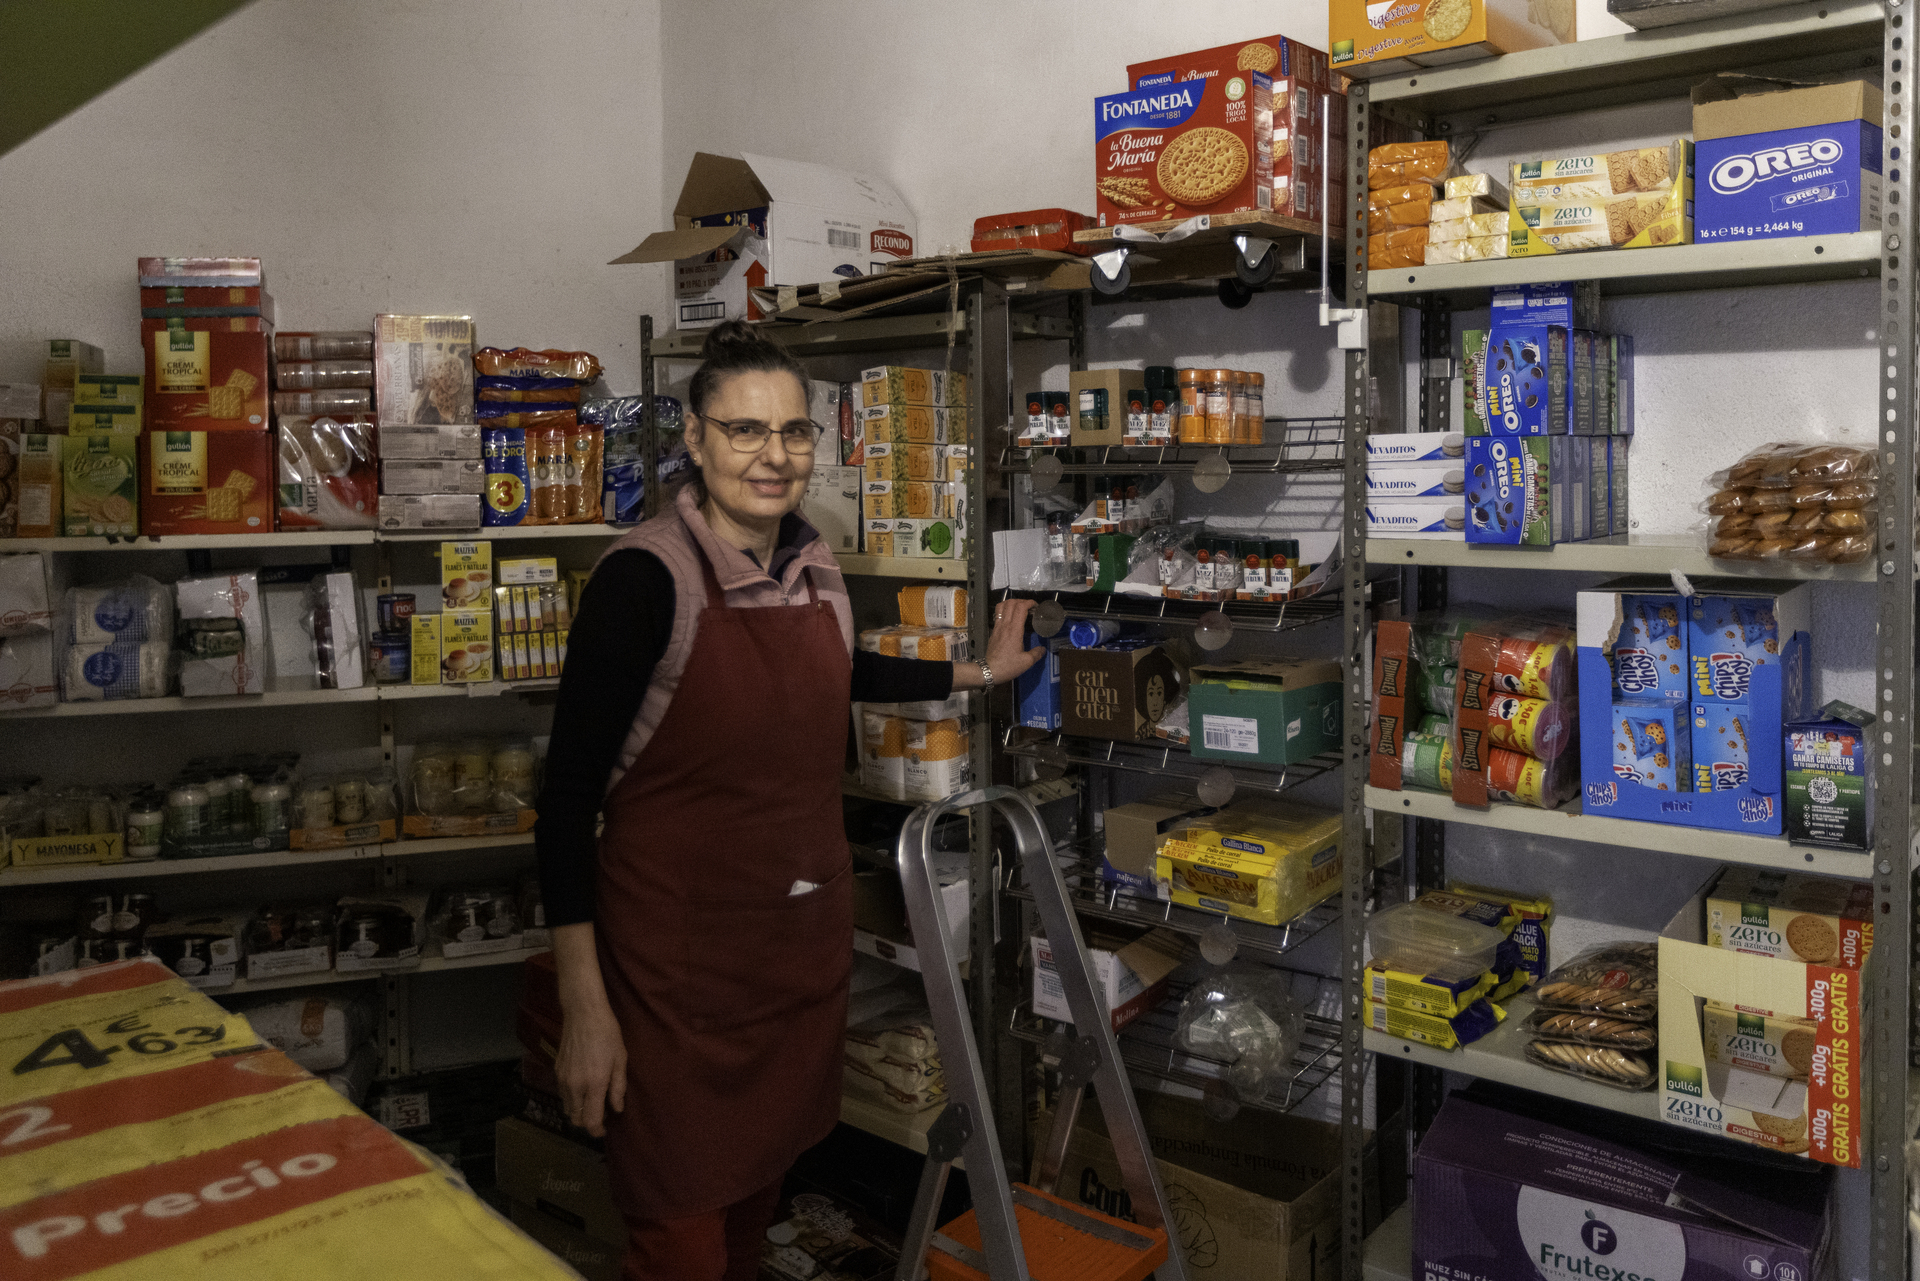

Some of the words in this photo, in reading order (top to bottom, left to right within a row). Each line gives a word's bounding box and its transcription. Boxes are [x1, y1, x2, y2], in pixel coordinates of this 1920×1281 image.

[1357, 37, 1404, 60] Digestive
[1404, 34, 1424, 46] Avena
[1332, 52, 1354, 63] gullón
[1139, 75, 1172, 88] FONTANEDA
[1187, 69, 1219, 81] Buena
[1102, 89, 1193, 122] FONTANEDA
[1166, 110, 1181, 120] 1881
[1225, 109, 1246, 118] TRIGO
[1226, 100, 1246, 111] 100%
[1226, 115, 1248, 124] LOCAL
[1111, 141, 1119, 151] la
[1119, 133, 1164, 152] Buena
[1107, 149, 1156, 171] María
[1556, 156, 1594, 170] zero
[1715, 141, 1840, 189] OREO
[1521, 170, 1541, 179] gullón
[1566, 167, 1594, 176] azúcares
[1791, 166, 1834, 184] ORIGINAL
[1785, 186, 1821, 205] OREO
[1136, 209, 1157, 218] CEREALES
[1555, 206, 1592, 220] zero
[1565, 217, 1592, 226] azúcares
[1660, 211, 1680, 220] Fibra
[1700, 228, 1710, 238] 16
[1711, 230, 1717, 238] x
[1730, 225, 1745, 236] 154
[1747, 226, 1754, 237] g
[1764, 221, 1790, 234] 2,464
[1792, 220, 1804, 232] kg
[874, 234, 910, 250] RECONDO
[1511, 238, 1528, 246] gullón
[171, 342, 194, 351] gullón
[162, 368, 202, 376] TROPICAL
[509, 368, 540, 377] MARÍA
[1476, 362, 1484, 399] CAMISETAS
[1477, 398, 1486, 420] GANAR
[1500, 373, 1519, 430] OREO
[166, 442, 192, 452] gullón
[485, 447, 498, 458] DE
[501, 446, 524, 457] ORO
[537, 454, 573, 464] MARÍA
[1524, 453, 1534, 475] GANAR
[536, 464, 576, 480] ORO
[1491, 442, 1510, 498] OREO
[306, 476, 318, 515] María
[1526, 474, 1534, 511] CAMISETAS
[454, 546, 478, 555] MAIZENA
[467, 563, 488, 571] NATILLAS
[454, 617, 478, 626] MAIZENA
[1075, 670, 1109, 687] car
[1380, 657, 1400, 696] PRINGLES
[1618, 652, 1642, 694] Chips
[1714, 658, 1741, 700] Chips
[1075, 685, 1119, 704] men
[1075, 700, 1114, 720] cita
[1518, 702, 1538, 726] 1,40€
[1026, 720, 1048, 729] PESCADO
[1378, 716, 1398, 756] PRINGLES
[1460, 729, 1482, 771] PRINGLES
[1792, 753, 1815, 763] GANAR
[1816, 754, 1854, 766] CAMISETAS
[1525, 766, 1533, 786] 1,40€
[1586, 781, 1612, 798] Chips
[1738, 797, 1766, 813] Chips
[36, 843, 97, 858] MAYONESA
[1172, 840, 1198, 850] AVECREM
[1227, 850, 1242, 858] corral
[1223, 838, 1242, 850] Gallina
[1243, 842, 1264, 854] Blanca
[1164, 849, 1189, 860] AVECREM
[1197, 856, 1210, 864] Pollo
[1218, 860, 1233, 868] corral
[1187, 868, 1256, 894] AVECREM
[1742, 914, 1769, 926] gullón
[1729, 925, 1782, 946] zero
[1729, 939, 1748, 948] sin
[1749, 941, 1782, 953] azúcares
[1842, 929, 1860, 967] +100g
[1738, 1004, 1770, 1016] DIGESTIVE
[1810, 979, 1830, 1022] +100g
[1830, 972, 1849, 1034] GRATIS
[104, 1015, 152, 1034] €
[1115, 1006, 1139, 1026] Molina
[127, 1023, 226, 1055] 63
[1738, 1025, 1764, 1037] gullón
[13, 1028, 124, 1076] 4
[1725, 1034, 1777, 1057] zero
[1726, 1048, 1744, 1056] sin
[1745, 1050, 1777, 1064] azúcares
[1736, 1057, 1766, 1070] DIGESTIVE
[1812, 1044, 1831, 1087] +100g
[1668, 1078, 1701, 1096] gullón
[1666, 1096, 1722, 1122] zero
[1666, 1111, 1686, 1122] sin
[1687, 1115, 1722, 1132] azúcares
[1812, 1108, 1832, 1150] +100g
[1506, 1132, 1540, 1144] PRODUCTO
[1732, 1125, 1778, 1144] DIGESTIVE
[1832, 1102, 1850, 1162] GRATIS
[1504, 1136, 1528, 1146] LIMPIAS
[1574, 1153, 1593, 1164] PARA
[1594, 1159, 1616, 1170] EVITAR
[1538, 1133, 1598, 1152] CONDICIONES
[1600, 1149, 1612, 1157] DE
[1246, 1150, 1306, 1182] Fórmula
[1544, 1169, 1578, 1182] HUMEDAD
[1578, 1178, 1608, 1189] RELATIVA
[1555, 1167, 1602, 1183] TEMPERATURA
[1604, 1180, 1625, 1190] ENTRE
[1566, 1163, 1654, 1193] PREFERENTEMENTE
[1592, 1227, 1609, 1250] F
[1424, 1260, 1450, 1275] NUEZ
[1453, 1269, 1471, 1281] SIN
